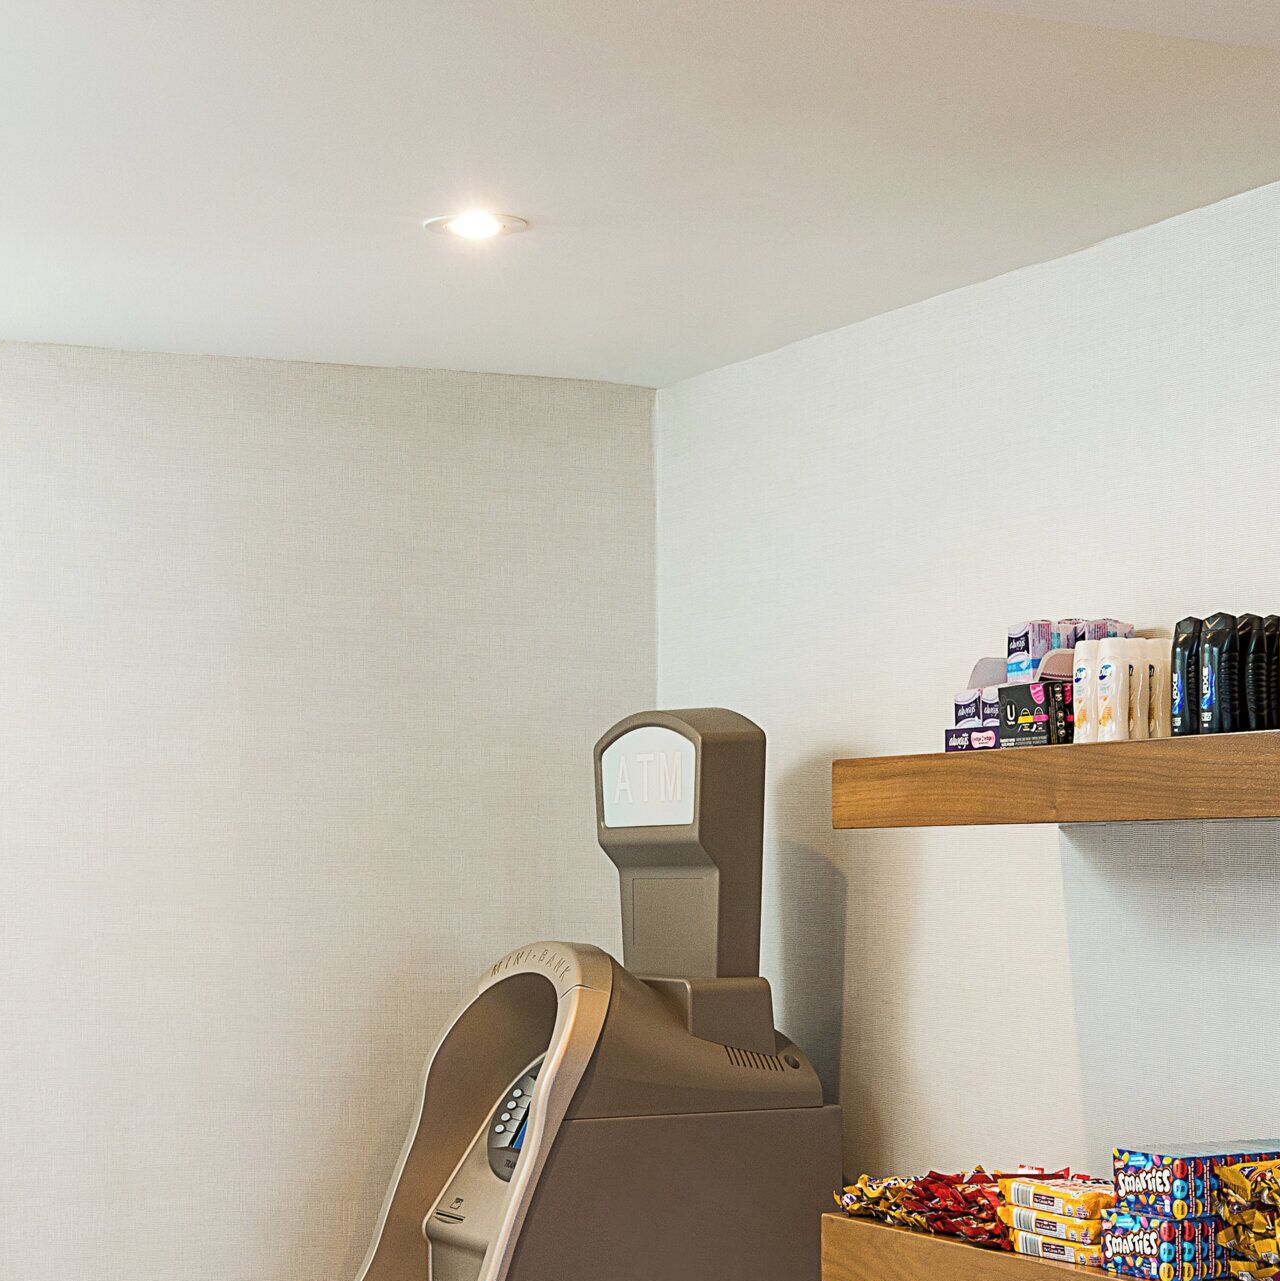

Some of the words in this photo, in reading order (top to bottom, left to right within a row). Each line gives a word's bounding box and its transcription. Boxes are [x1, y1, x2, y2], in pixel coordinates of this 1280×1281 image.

[614, 750, 682, 804] ATM
[1118, 1168, 1171, 1198] SMARTIES
[1105, 1227, 1158, 1259] SMARTIES
